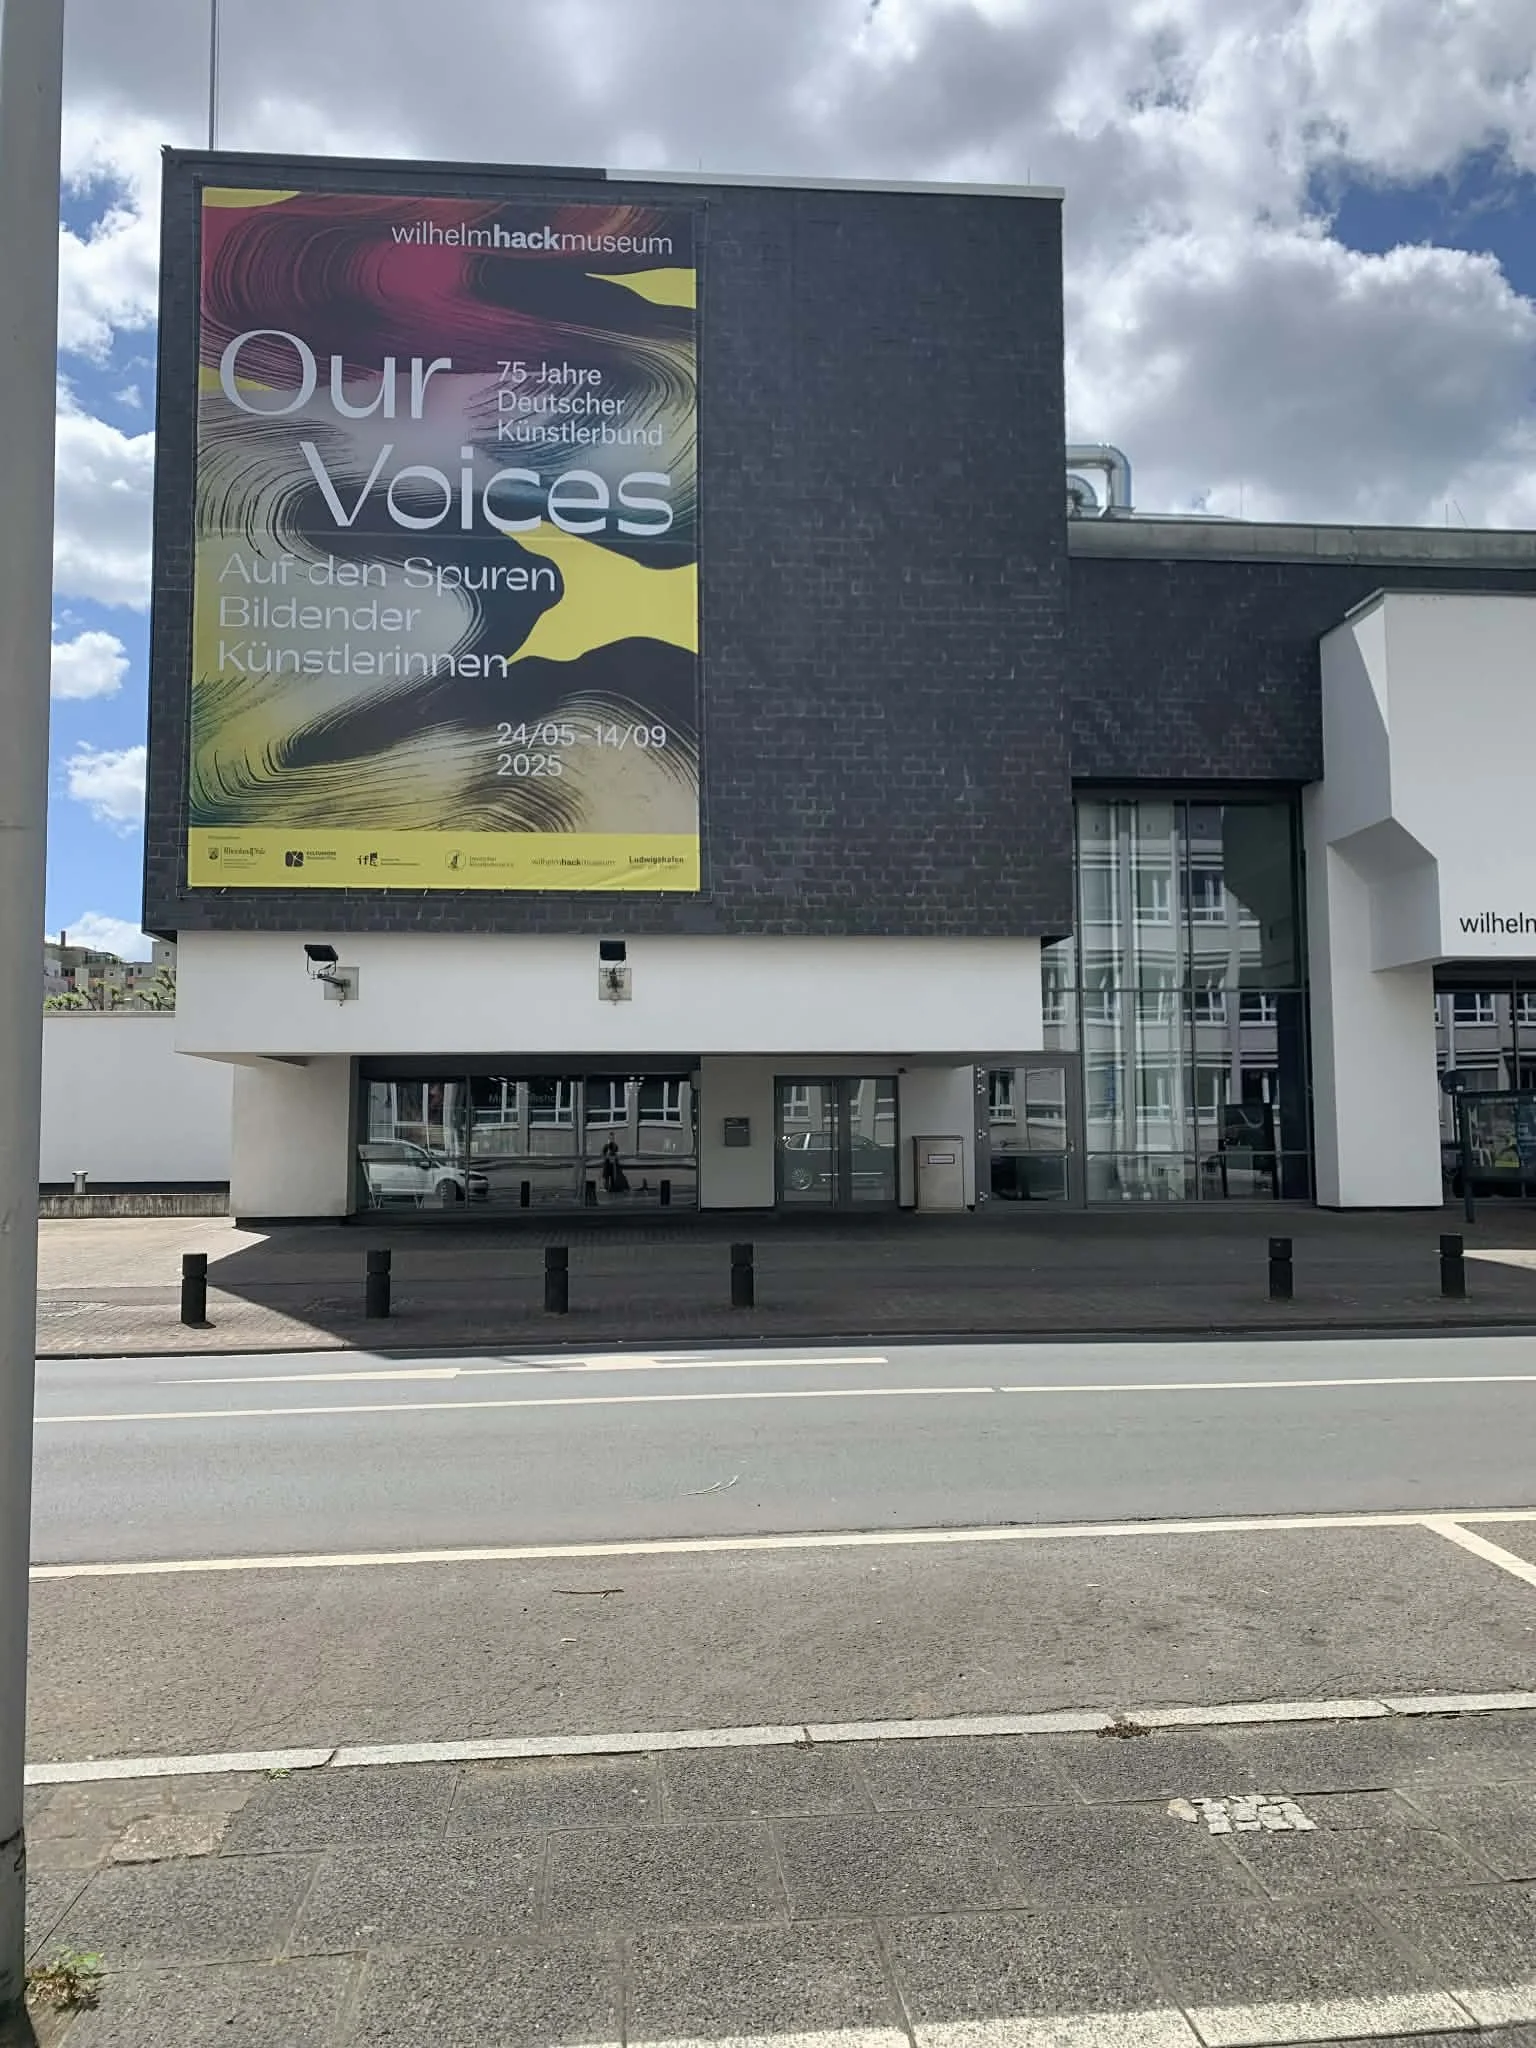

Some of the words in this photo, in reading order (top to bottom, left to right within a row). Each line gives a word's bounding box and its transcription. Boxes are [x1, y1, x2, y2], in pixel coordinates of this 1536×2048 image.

[391, 221, 674, 256] wilhelmhackmuseum
[220, 329, 452, 420] Our
[497, 361, 527, 383] 75
[537, 361, 602, 385] Jahre
[498, 391, 625, 416] Deutscher
[498, 419, 663, 446] Künstlerbund
[300, 441, 674, 536] Voices
[218, 553, 297, 585] Auf
[307, 556, 386, 587] den
[403, 557, 557, 596] Spuren
[218, 596, 421, 632] Bildender
[218, 640, 508, 679] Künstlerinnen
[497, 754, 562, 777] 2025
